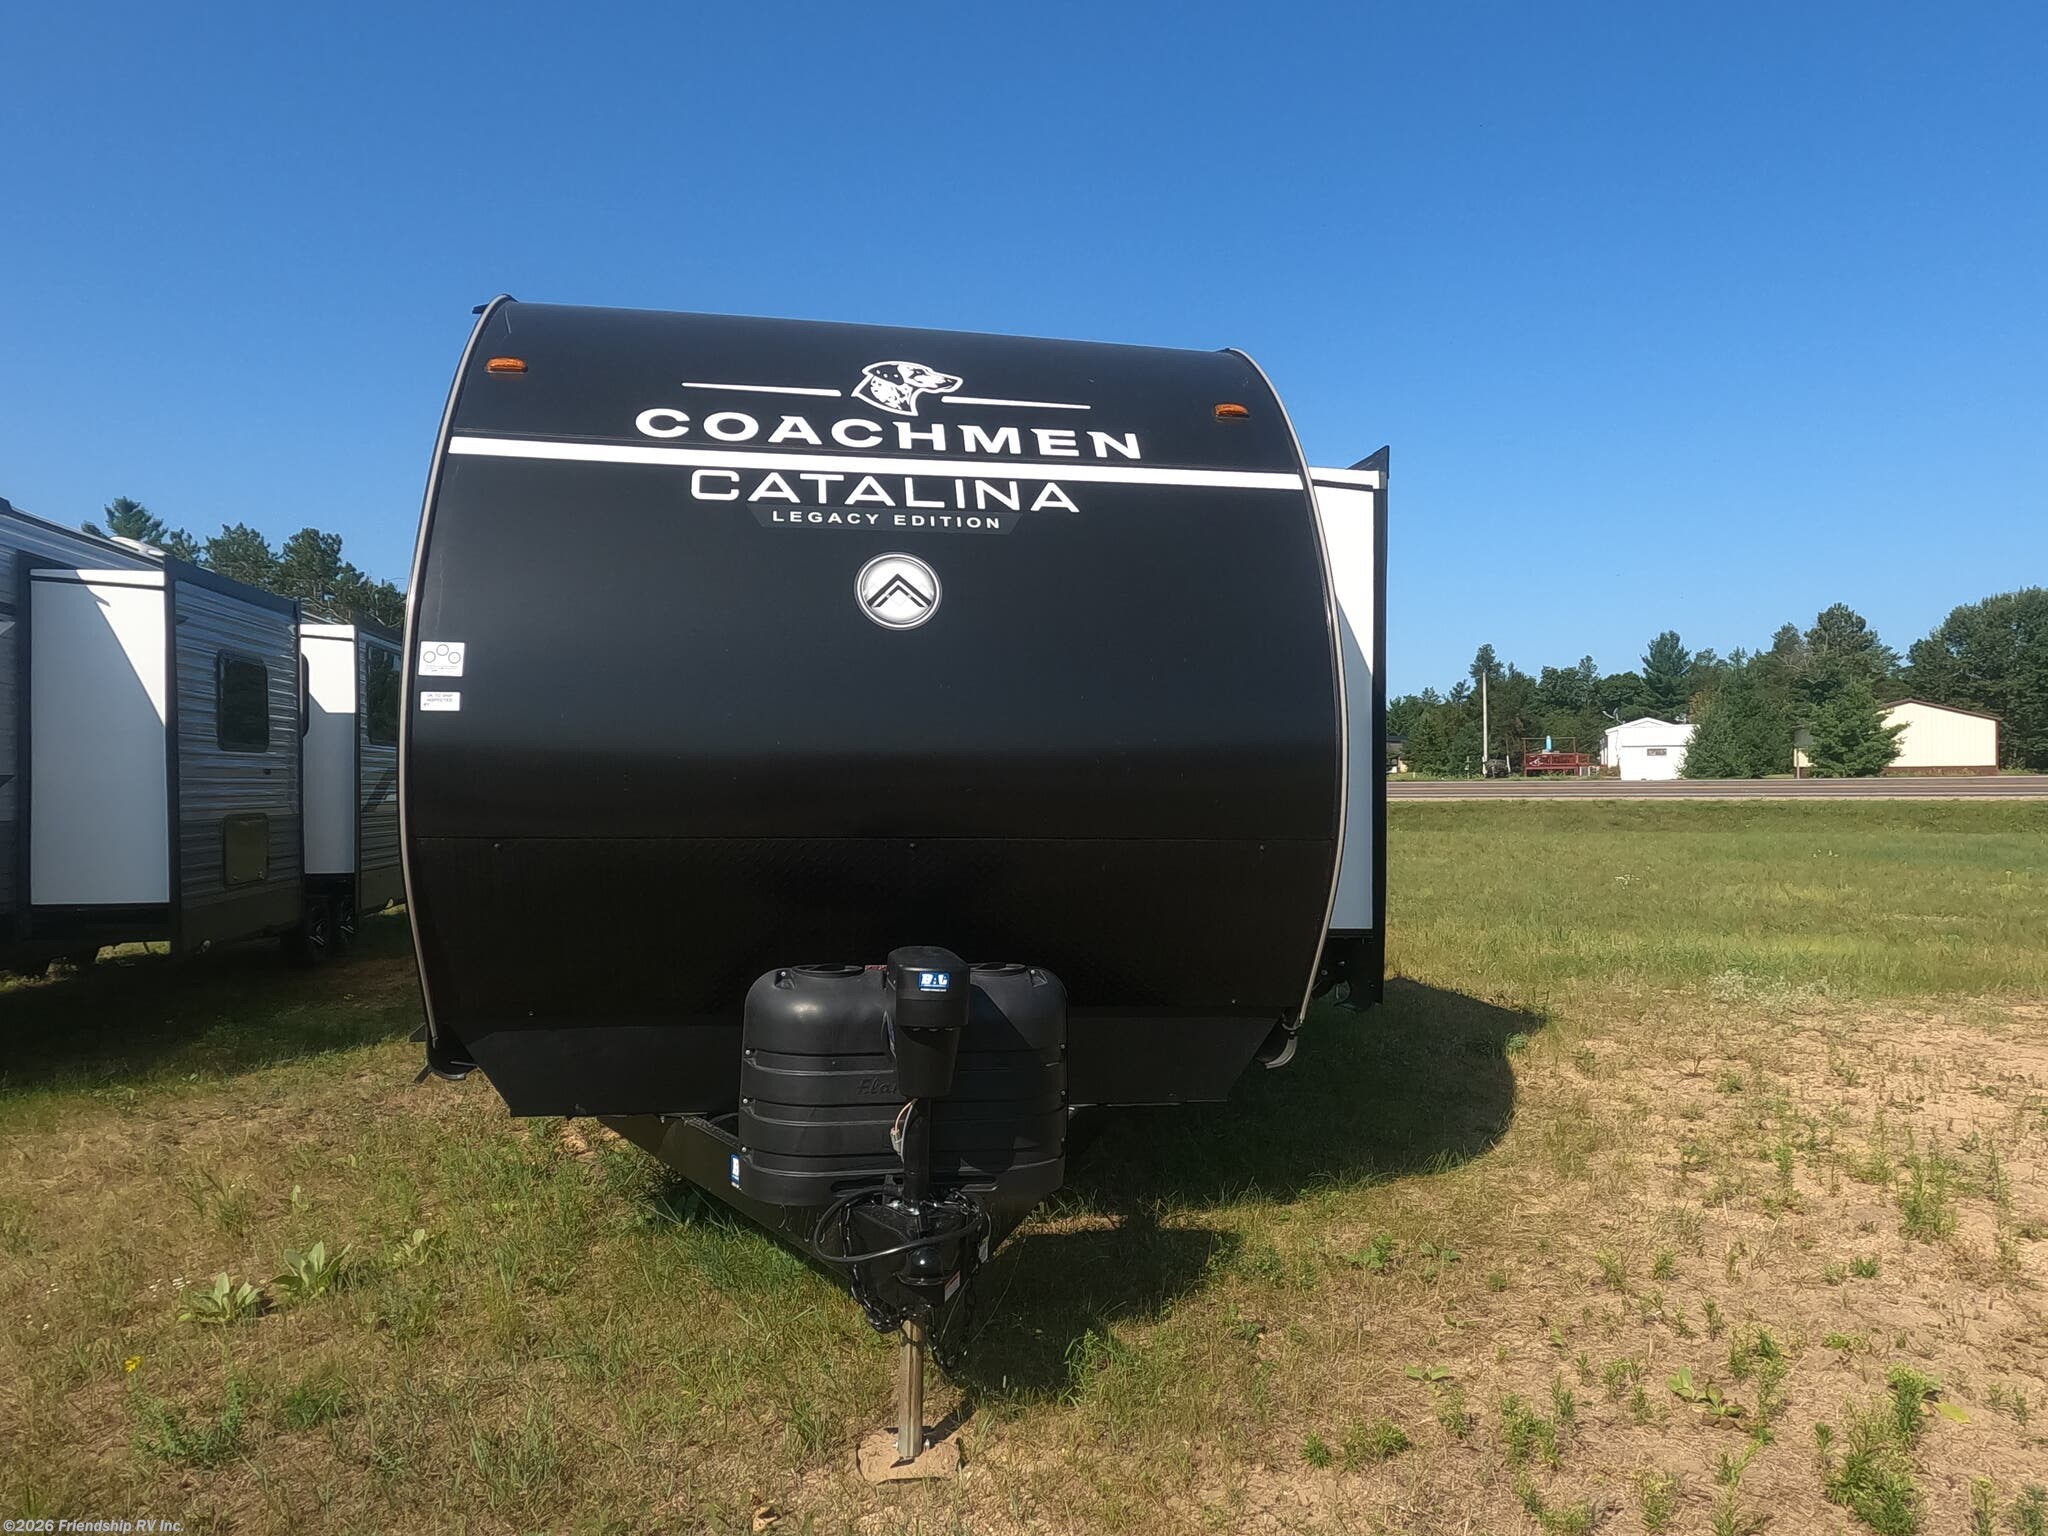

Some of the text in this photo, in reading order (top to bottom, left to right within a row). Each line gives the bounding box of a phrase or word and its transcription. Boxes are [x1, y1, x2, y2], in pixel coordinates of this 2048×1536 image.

[635, 407, 1142, 460] COACHMEN
[690, 468, 1080, 514] CATALINA
[772, 510, 1000, 529] LEGACY EDITION
